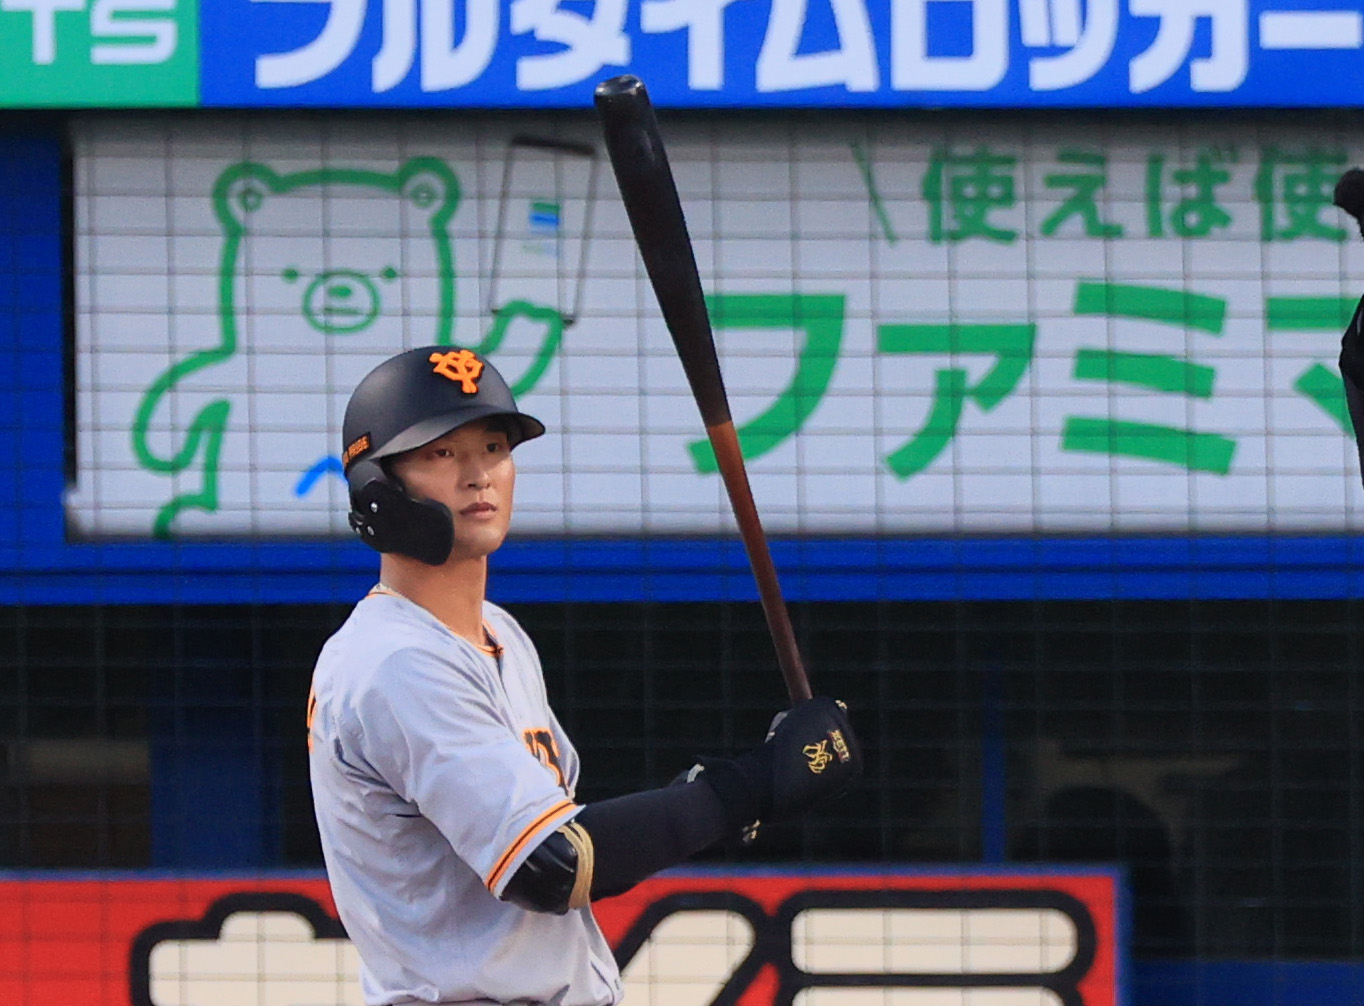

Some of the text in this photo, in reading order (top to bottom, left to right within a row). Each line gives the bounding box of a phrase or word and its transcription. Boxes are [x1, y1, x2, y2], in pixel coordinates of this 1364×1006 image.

[249, 0, 1364, 93] フルタイムロッカー
